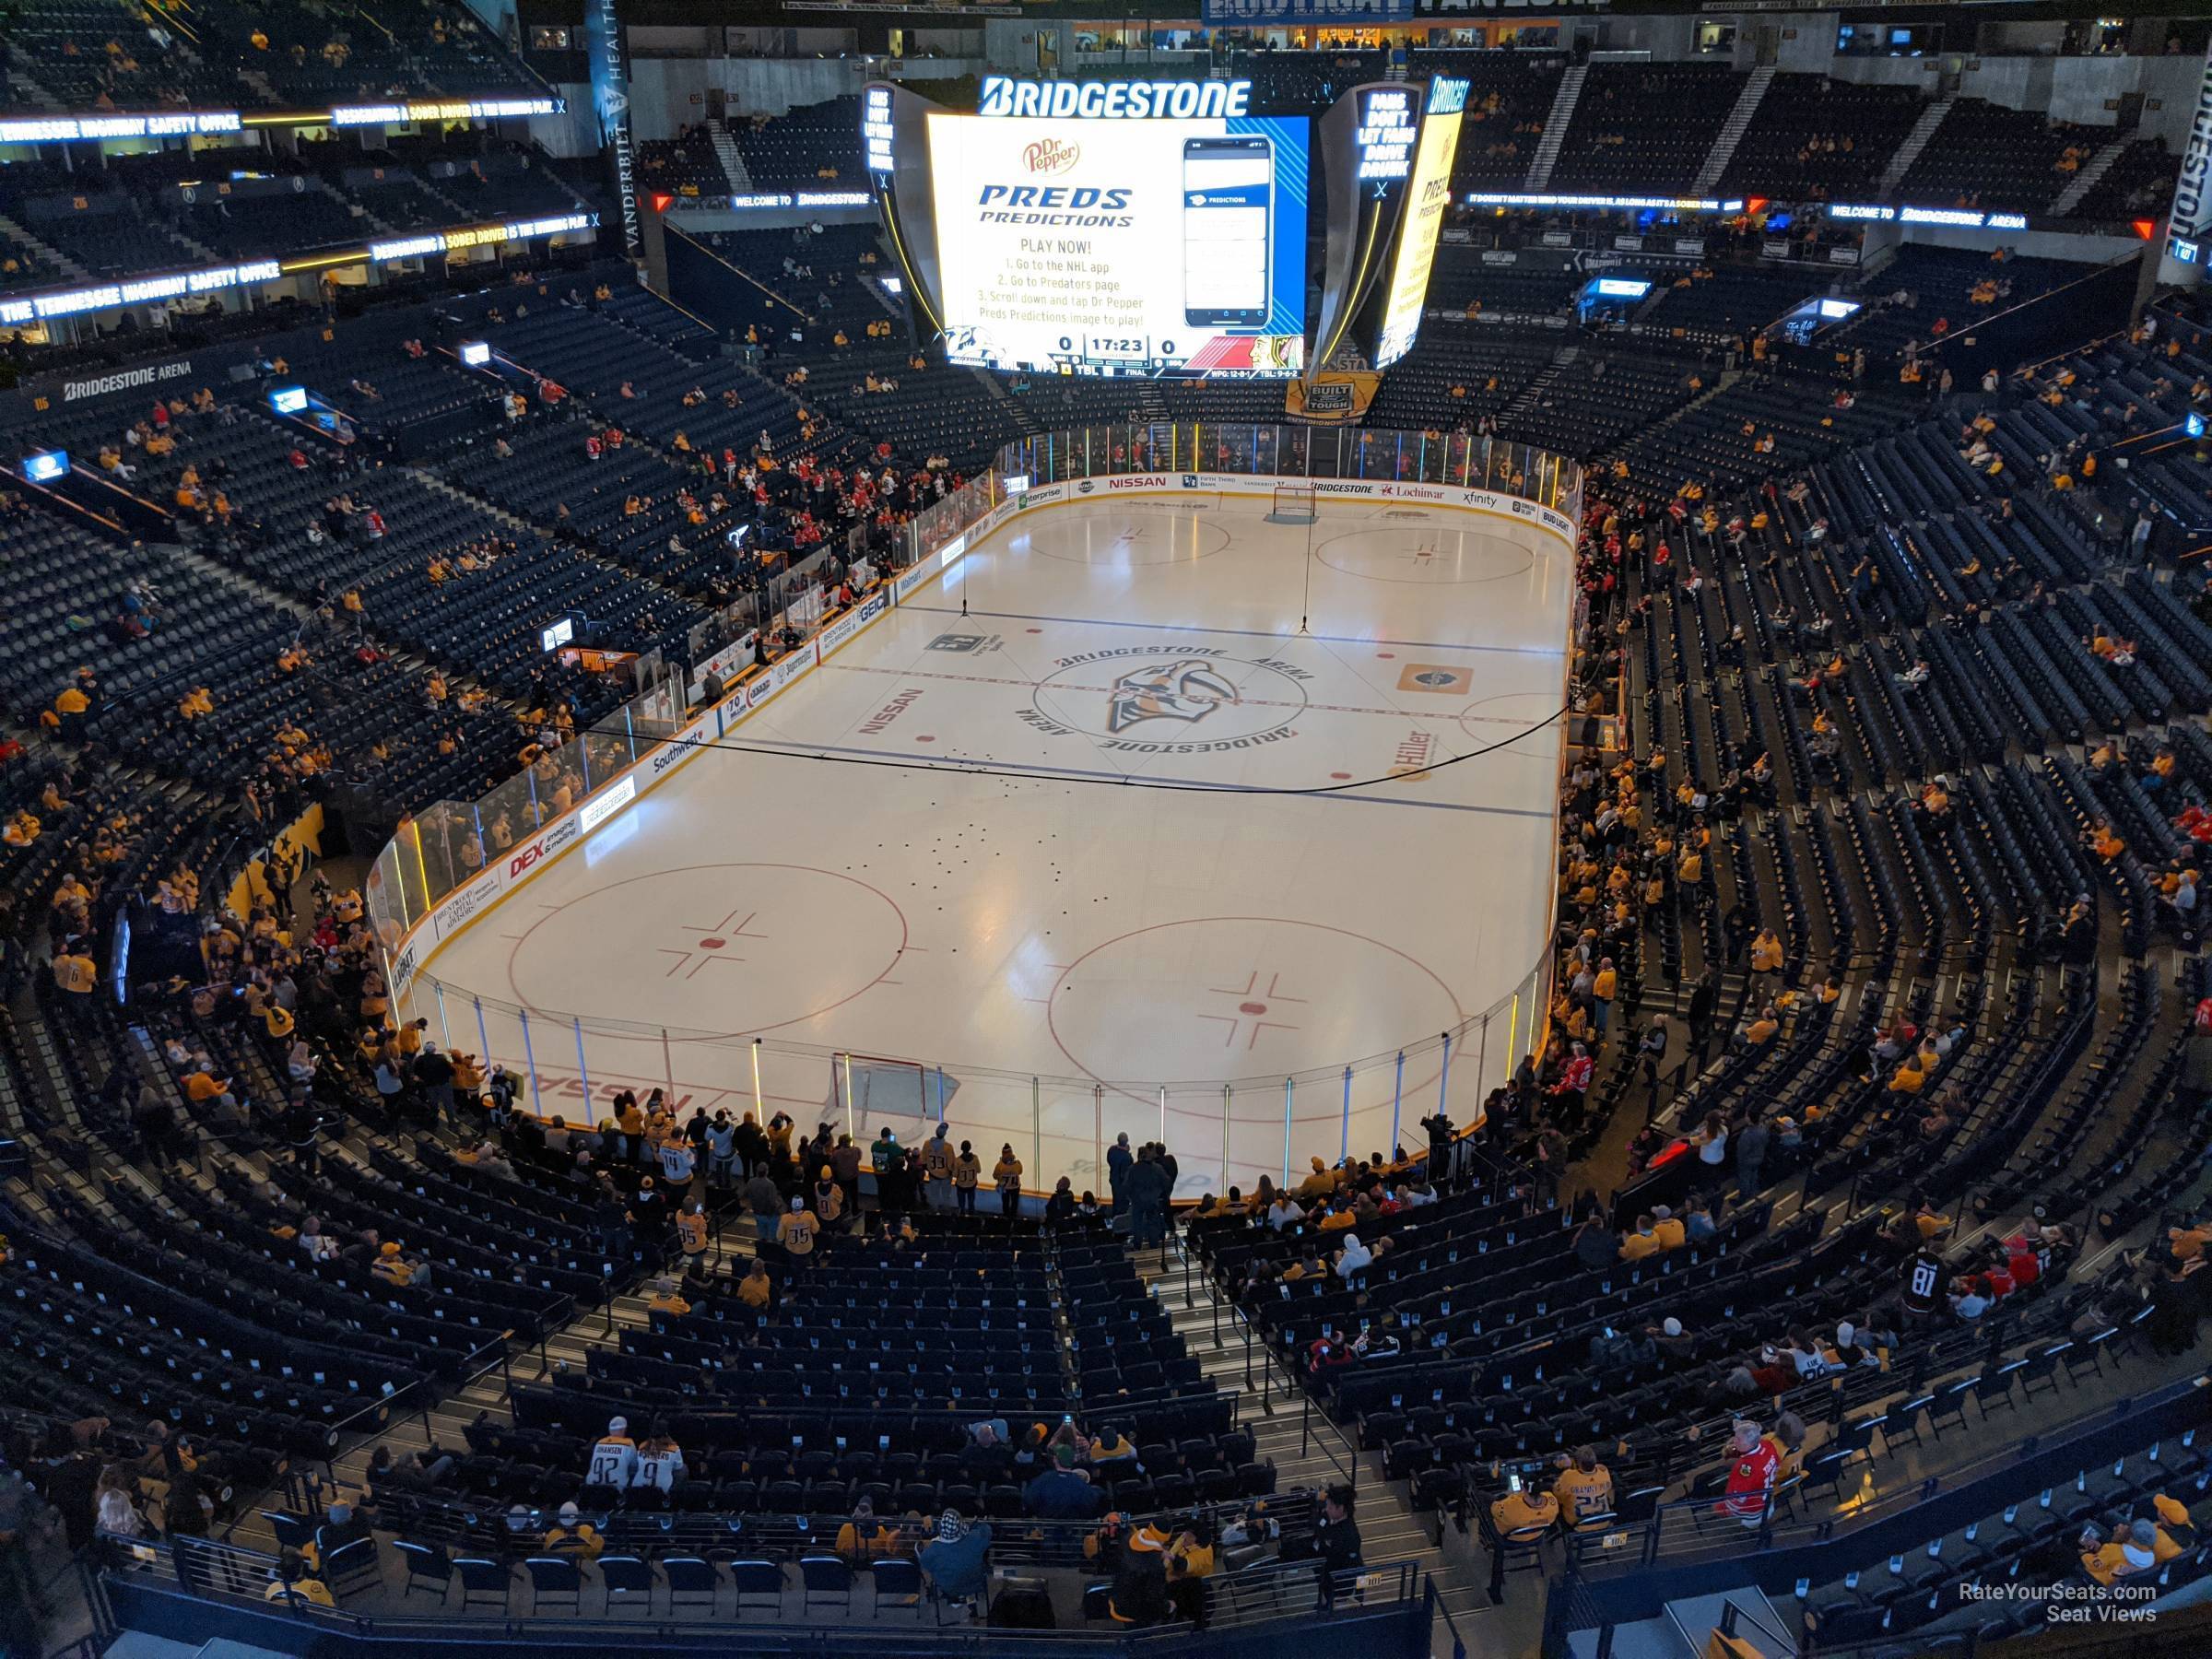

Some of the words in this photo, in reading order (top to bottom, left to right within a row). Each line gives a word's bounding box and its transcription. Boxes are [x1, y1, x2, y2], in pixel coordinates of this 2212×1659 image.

[603, 0, 622, 80] HEALTH
[980, 77, 1252, 118] BRIDGESTONE
[335, 107, 399, 124] DESIGNATING
[400, 106, 408, 120] A
[409, 105, 440, 120] SOBER
[441, 103, 471, 118] DRIVER
[472, 103, 481, 117] IS
[482, 102, 497, 116] THE
[498, 100, 532, 115] WINNING
[1368, 111, 1409, 126] DON'T
[80, 118, 146, 136] HIGHWAY
[149, 116, 196, 135] SAFETY
[198, 114, 241, 132] OFFICE
[1359, 128, 1382, 144] LET
[1382, 127, 1416, 143] FANS
[1029, 143, 1076, 172] Pepper
[1041, 138, 1062, 155] Dr
[1365, 145, 1407, 160] DRIVE
[1359, 160, 1409, 177] DRUNK
[616, 124, 640, 249] VANDERBILT
[979, 184, 1133, 210] PREDS
[735, 195, 778, 206] WELCOME
[780, 195, 791, 206] TO
[798, 194, 869, 206] BRIDGESTONE
[1558, 195, 1577, 204] YOUR
[1578, 196, 1606, 205] DRIVER
[1626, 197, 1646, 206] LONG
[980, 211, 1134, 228] PREDICTIONS
[1831, 206, 1880, 218] WELCOME
[1881, 208, 1894, 219] TO
[1900, 208, 1984, 226] BRIDGESTONE
[1987, 215, 2026, 229] ARENA
[372, 237, 437, 260] DESIGNATING
[438, 236, 446, 250] A
[446, 232, 476, 249] SOBER
[477, 228, 507, 243] DRIVER
[507, 225, 518, 239] IS
[519, 223, 534, 238] THE
[535, 218, 568, 235] WINNING
[1021, 239, 1053, 253] PLAY
[1058, 240, 1091, 254] NOW!
[1006, 258, 1013, 269] 1.
[1016, 258, 1029, 270] Go
[1033, 260, 1042, 270] to
[1047, 260, 1063, 271] the
[1066, 261, 1087, 272] NHL
[1090, 264, 1109, 276] app
[2, 300, 34, 322] THE
[35, 287, 121, 316] TENNESSEE
[122, 276, 186, 302] HIGHWAY
[188, 268, 237, 291] SAFETY
[240, 262, 280, 283] OFFICE
[998, 275, 1006, 286] 2.
[1010, 276, 1024, 287] Go
[1027, 276, 1037, 287] to
[1041, 277, 1091, 289] Predators
[1095, 280, 1121, 292] page
[978, 290, 987, 301] 3.
[990, 291, 1018, 303] Scroll
[1021, 293, 1046, 305] down
[1050, 295, 1067, 306] and
[1071, 296, 1088, 308] tap
[1091, 296, 1102, 307] Dr
[1107, 298, 1144, 311] Pepper
[980, 307, 1006, 320] Preds
[1010, 309, 1066, 323] Predictions
[1070, 312, 1100, 326] image
[1104, 314, 1115, 325] to
[1118, 313, 1144, 328] play!
[1059, 336, 1072, 350] 0
[1092, 338, 1142, 351] 17:23
[1162, 339, 1175, 354] 0
[1033, 362, 1058, 373] WPG
[1077, 365, 1099, 376] TBL
[65, 368, 155, 401] BRIDGESTONE
[159, 361, 192, 381] ARENA
[1312, 386, 1347, 394] BUILT
[34, 397, 49, 411] 116
[1110, 477, 1166, 488] NISSAN
[1311, 481, 1373, 494] BRIDGESTONE
[1396, 486, 1444, 500] Lochinvar
[1464, 491, 1497, 508] xfinity
[1543, 512, 1556, 524] BUD
[1556, 517, 1570, 532] LIGHT
[900, 570, 921, 592] Walmart
[861, 594, 887, 622] GEIC
[824, 618, 851, 642] BRENTWOOD
[1053, 646, 1229, 667] BRIDGESTONE
[1251, 657, 1314, 681] ARENA
[858, 688, 924, 735] NISSAN
[1015, 709, 1076, 735] ARENA
[1099, 726, 1299, 754] BRIDGESTONE
[654, 731, 699, 772] Southwest
[1394, 731, 1430, 767] Hiller
[547, 818, 575, 842] imaging
[511, 840, 545, 879] DEX
[551, 829, 576, 850] mailing
[437, 889, 473, 923] BRENTWOOD
[664, 1154, 677, 1171] 14
[788, 1228, 809, 1245] 35
[1912, 1266, 1936, 1298] 81
[593, 1457, 618, 1485] 92
[644, 1462, 658, 1486] 9
